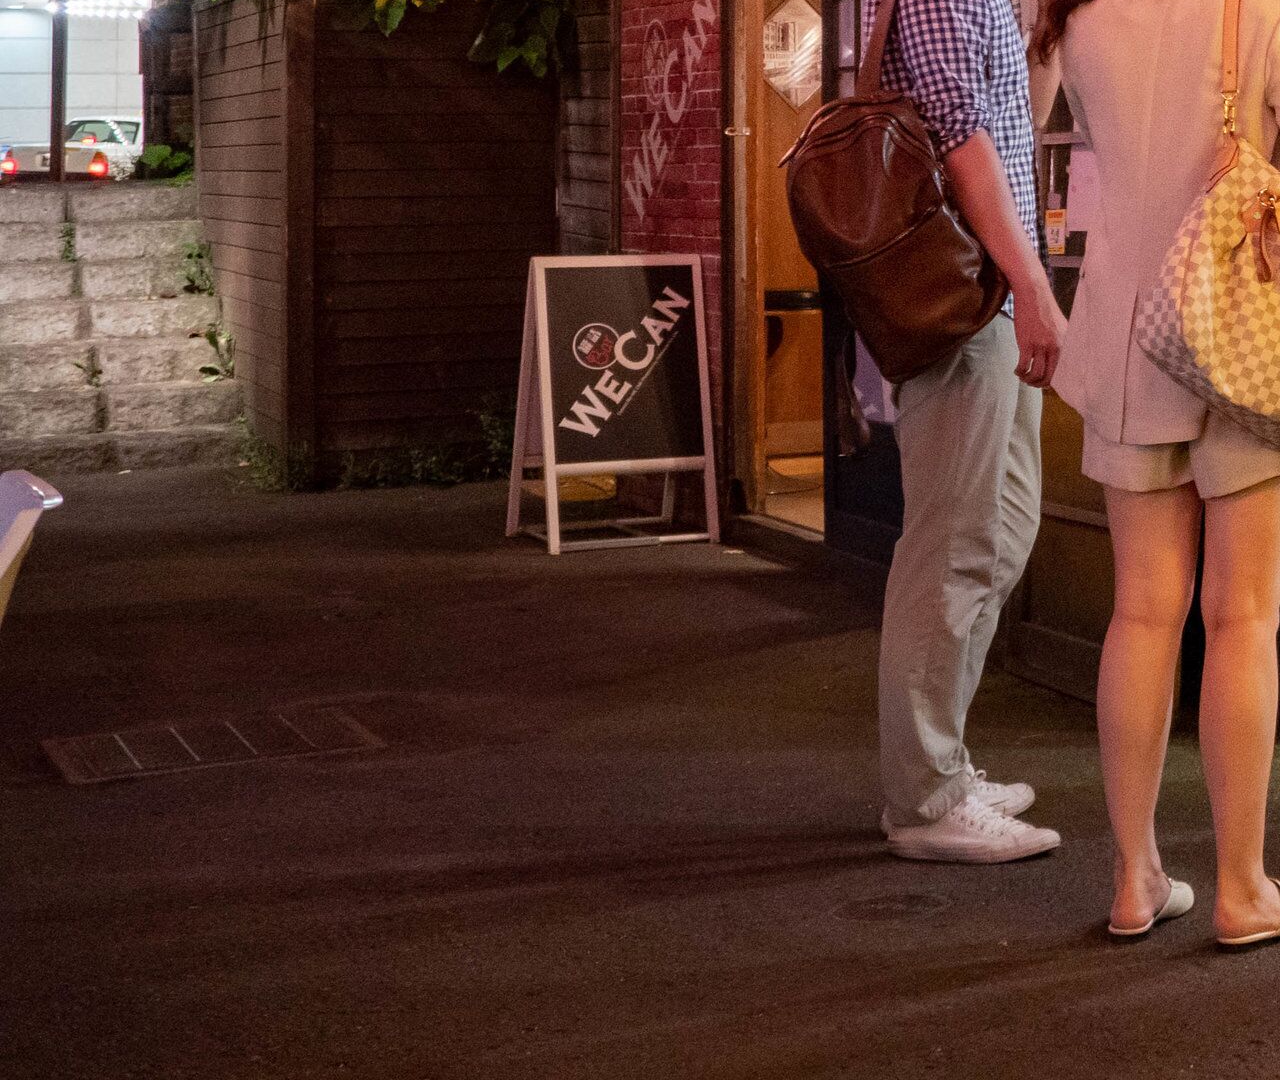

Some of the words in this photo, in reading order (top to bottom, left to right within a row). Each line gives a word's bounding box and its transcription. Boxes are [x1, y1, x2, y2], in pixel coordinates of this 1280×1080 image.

[625, 111, 668, 222] WE
[558, 369, 632, 438] WE
[613, 286, 691, 370] CAN
